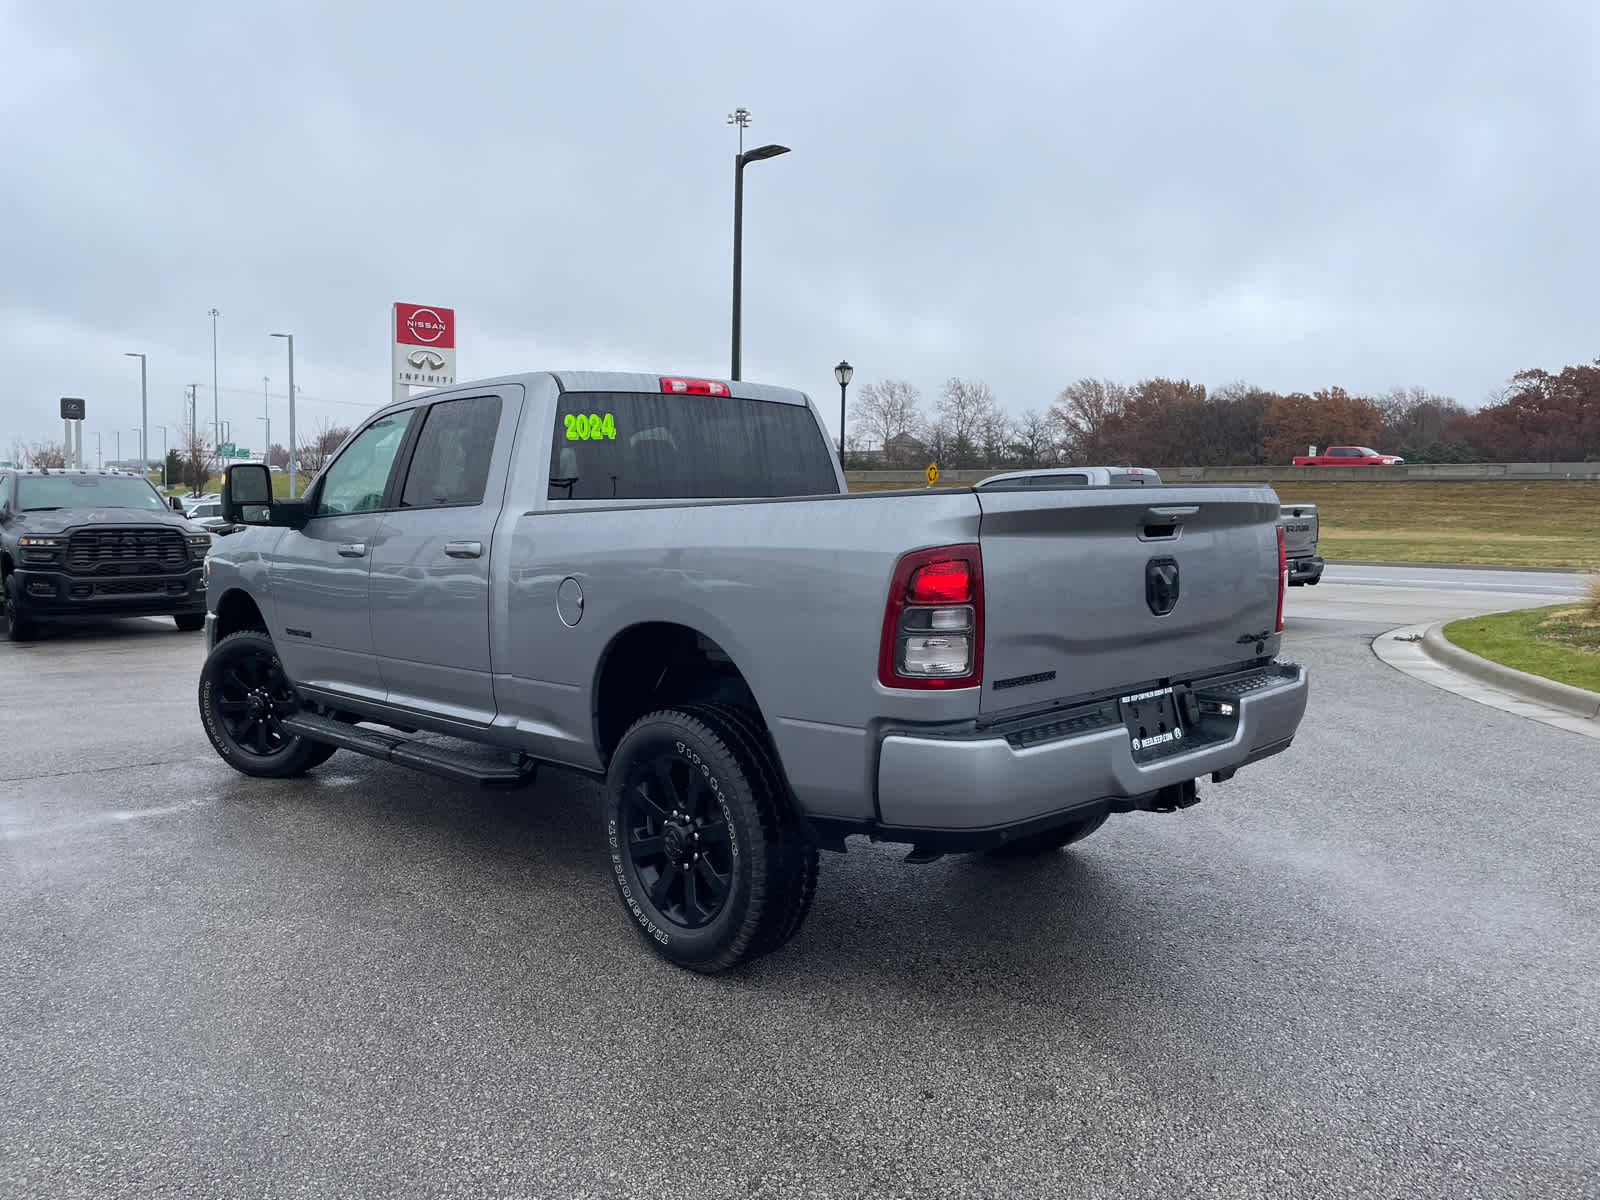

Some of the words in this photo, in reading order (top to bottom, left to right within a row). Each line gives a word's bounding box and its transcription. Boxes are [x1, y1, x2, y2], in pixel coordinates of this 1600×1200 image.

[407, 320, 446, 331] NISSAN
[400, 372, 454, 384] INFINITI
[564, 412, 616, 441] 2024
